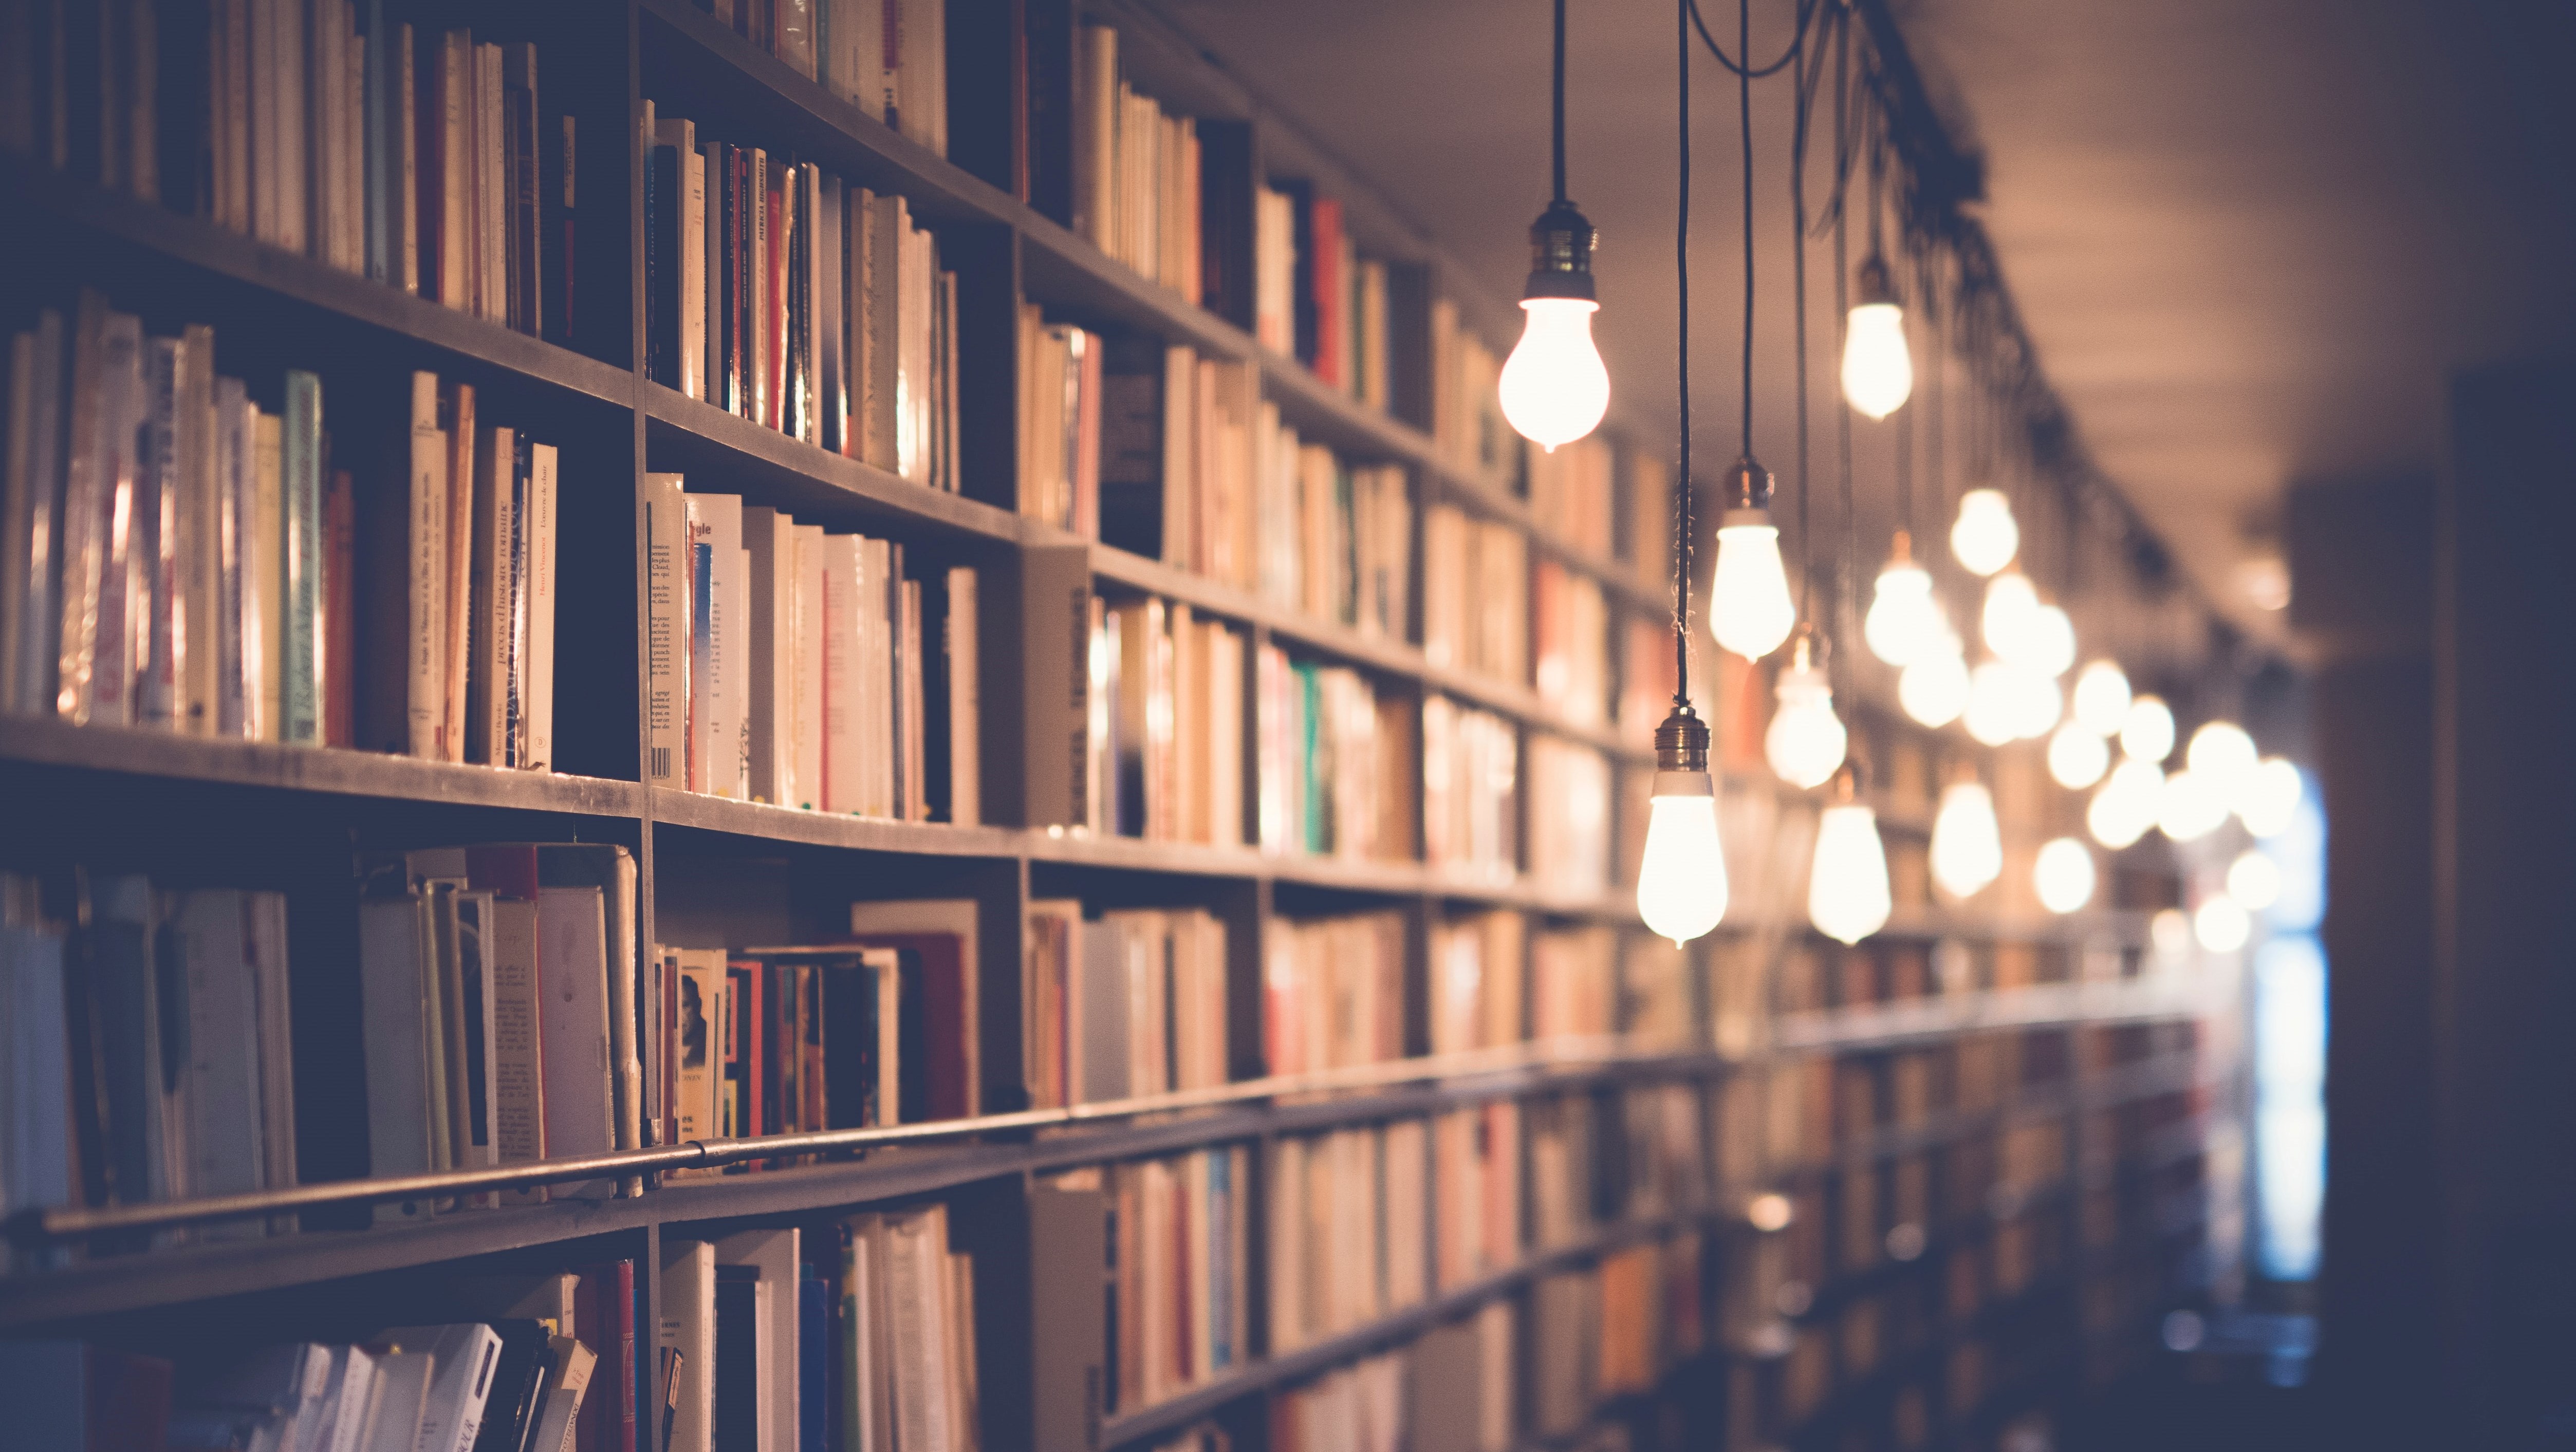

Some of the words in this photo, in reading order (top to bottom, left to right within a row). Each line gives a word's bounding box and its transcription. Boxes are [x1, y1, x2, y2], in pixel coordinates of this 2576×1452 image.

[498, 504, 507, 558] romaine
[495, 564, 506, 623] d'histoire
[496, 626, 506, 664] précis
